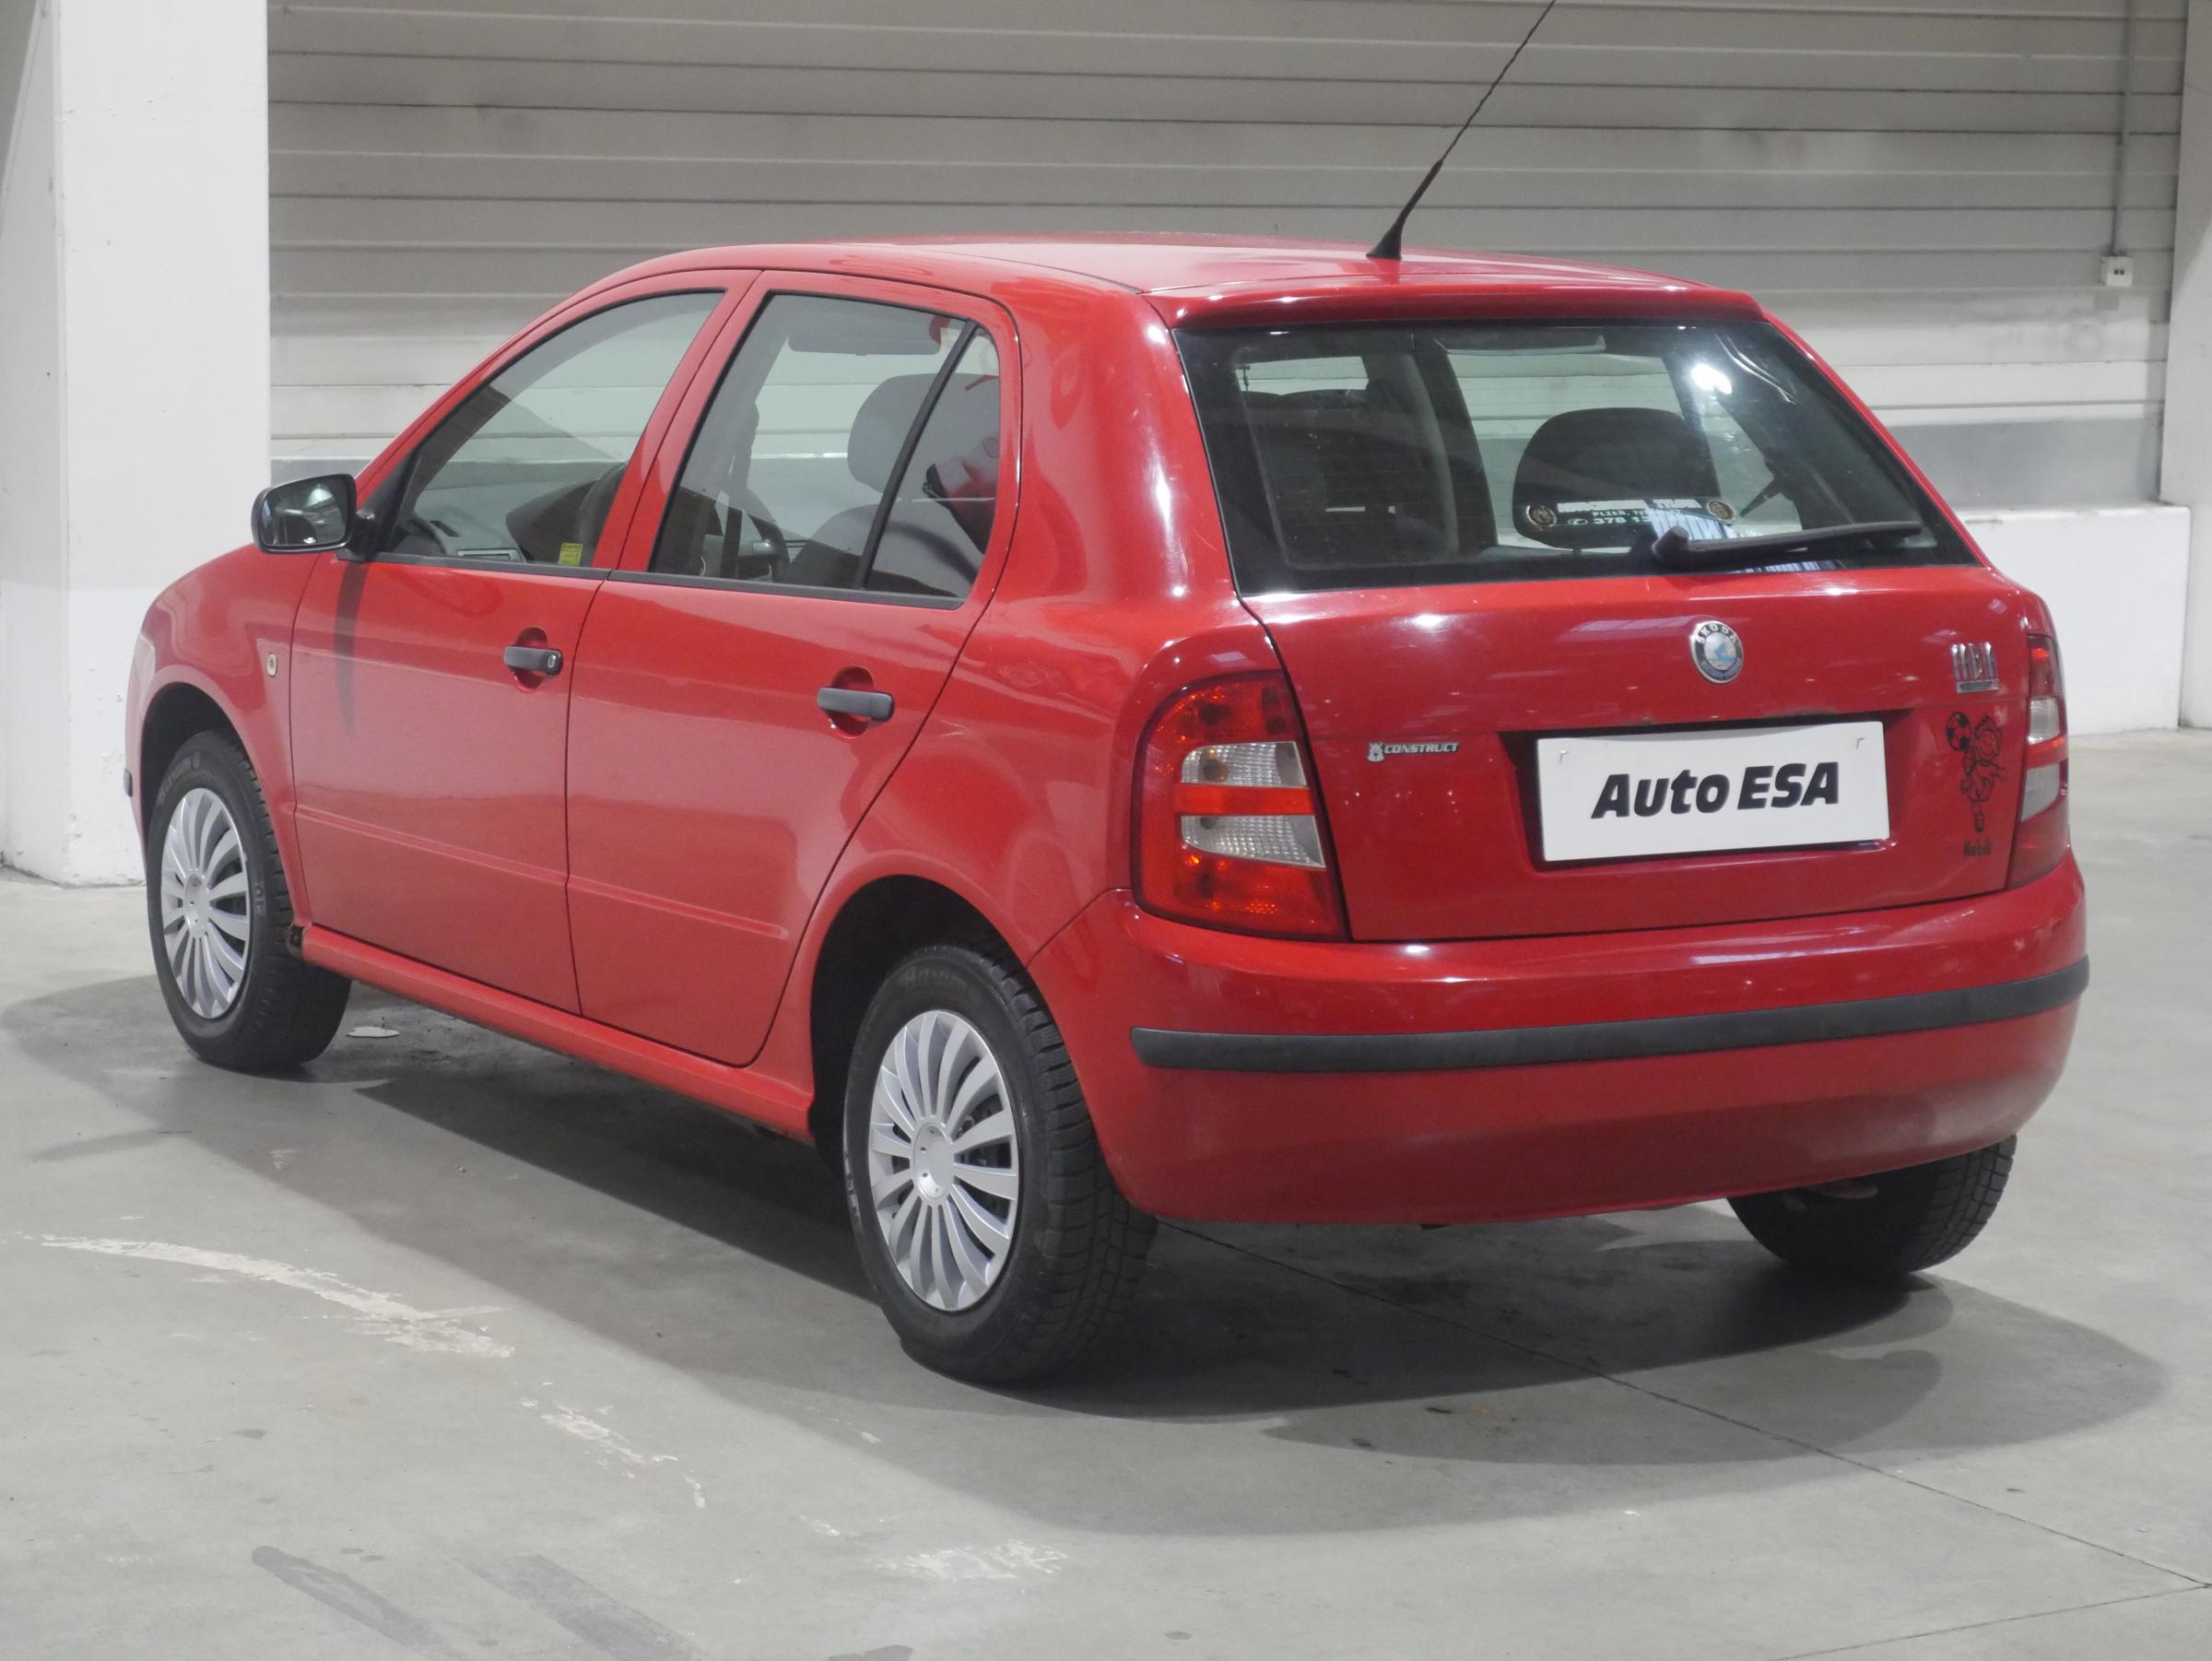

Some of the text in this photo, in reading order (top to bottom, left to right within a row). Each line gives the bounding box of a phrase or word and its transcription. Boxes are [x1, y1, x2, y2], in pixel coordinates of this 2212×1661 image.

[1384, 742, 1458, 754] CONSTRUCT
[1591, 761, 1840, 819] Auto ESA
